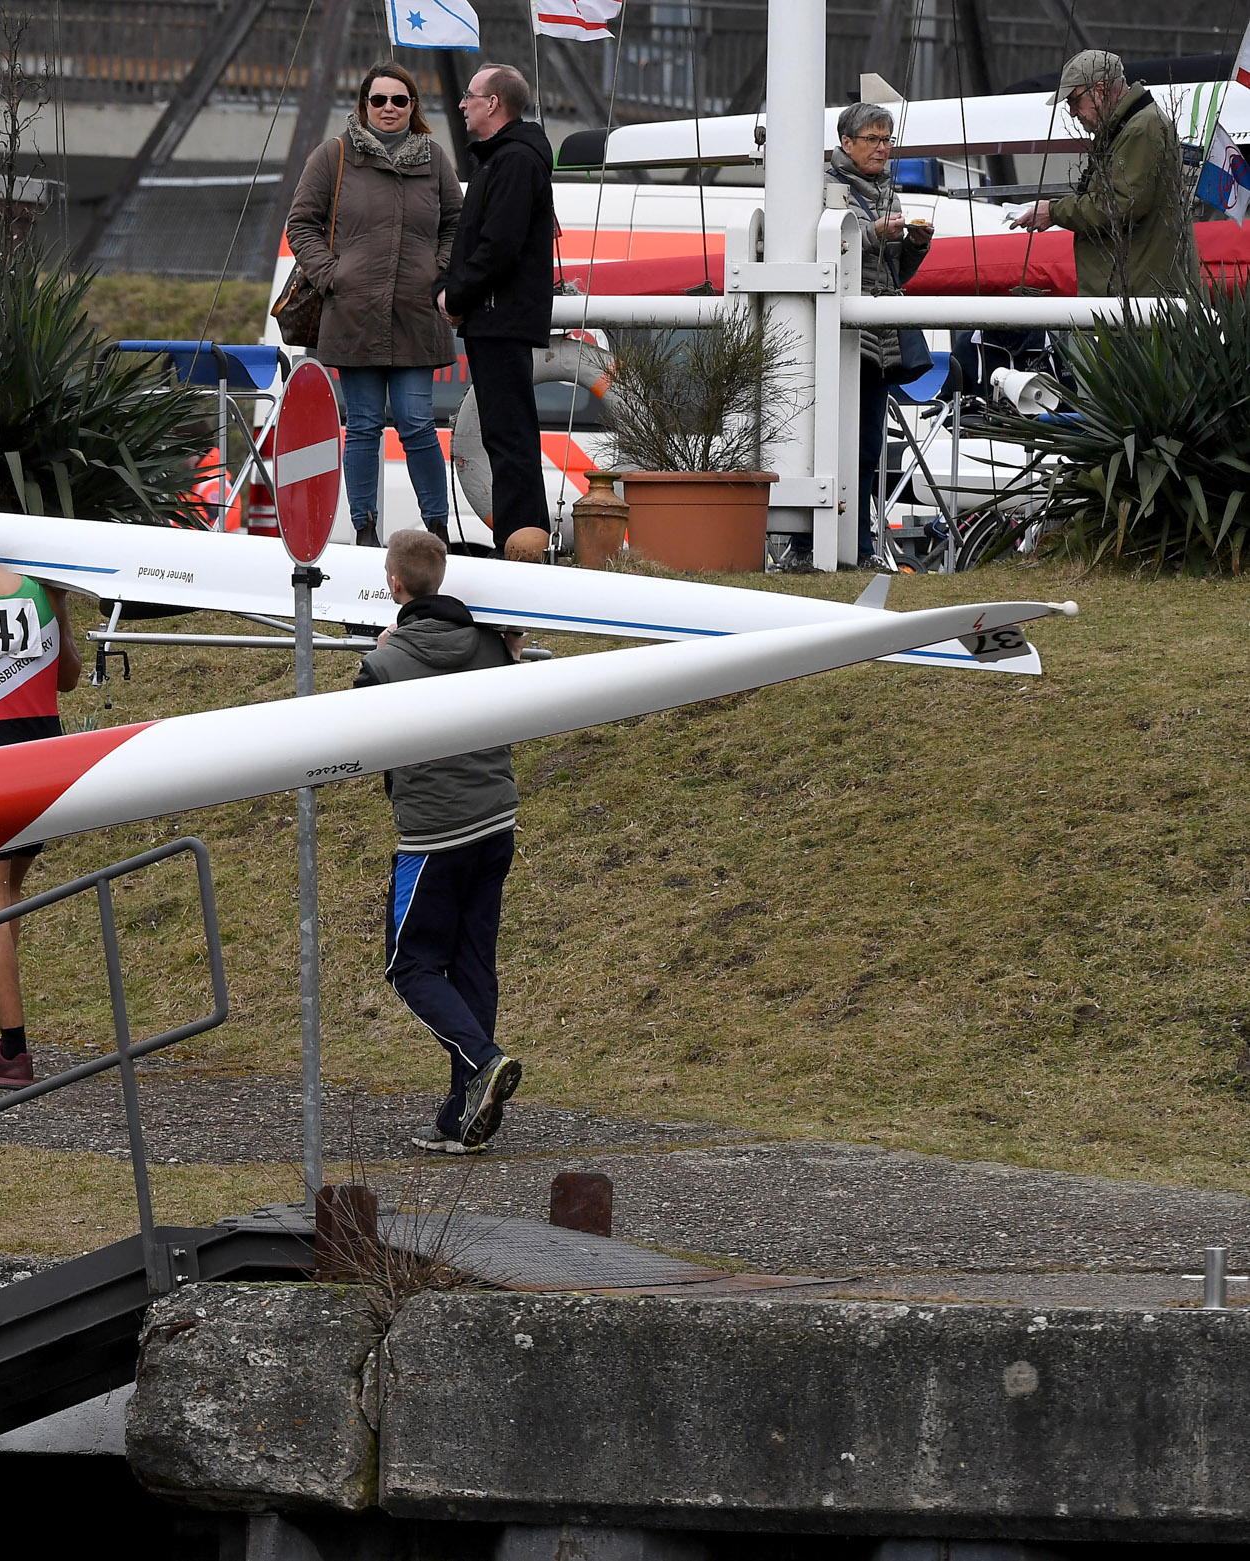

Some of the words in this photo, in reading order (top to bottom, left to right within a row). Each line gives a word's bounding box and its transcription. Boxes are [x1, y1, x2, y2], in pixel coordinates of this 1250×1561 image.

[137, 566, 165, 580] Konrad
[166, 570, 194, 583] Werner
[357, 589, 370, 601] RV
[371, 588, 392, 601] urger
[41, 636, 54, 652] RV
[974, 630, 1023, 655] 37
